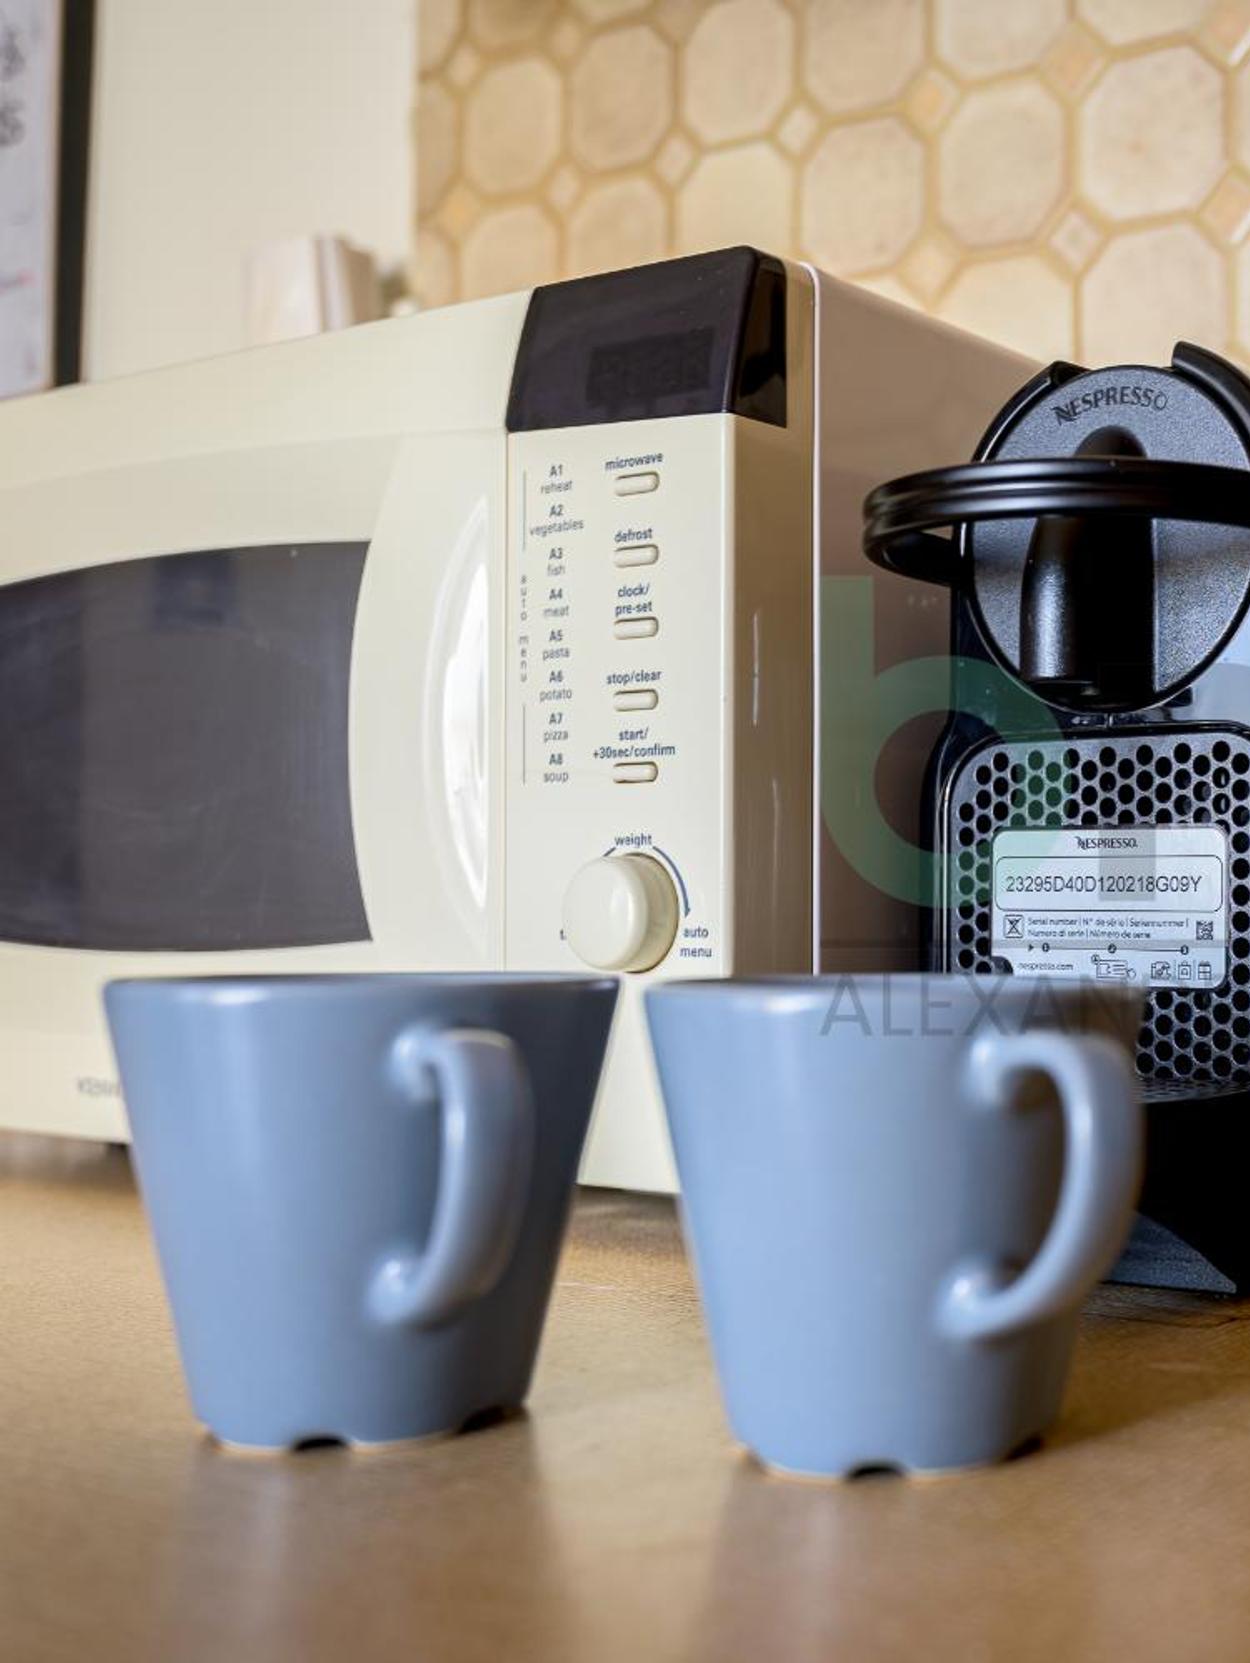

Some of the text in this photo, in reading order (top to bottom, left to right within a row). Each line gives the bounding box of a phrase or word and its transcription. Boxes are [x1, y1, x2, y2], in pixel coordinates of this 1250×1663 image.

[1052, 386, 1169, 426] NESPRESSO
[605, 452, 664, 471] microwave
[550, 464, 563, 477] A1
[541, 480, 573, 494] reheat
[550, 504, 564, 517] A2
[529, 518, 585, 538] vegetables
[614, 527, 653, 543] defrost
[549, 547, 563, 560] A3
[547, 563, 566, 577] fish
[549, 588, 563, 600] A4
[617, 583, 651, 598] clock/
[543, 604, 570, 618] meat
[614, 600, 653, 617] pre-set
[549, 629, 563, 642] A5
[542, 647, 571, 661] pasta
[549, 670, 564, 683] A6
[606, 669, 662, 685] stop/clear
[539, 688, 573, 702] potato
[549, 712, 563, 724] A7
[543, 728, 569, 742] pizza
[618, 727, 650, 741] start/
[592, 743, 676, 759] +30sec/confirm
[549, 753, 563, 765] A8
[543, 770, 569, 784] soup
[614, 833, 653, 848] weight
[1006, 874, 1202, 893] 23295D40D120218G09Y
[683, 927, 709, 939] auto
[680, 946, 713, 958] menu
